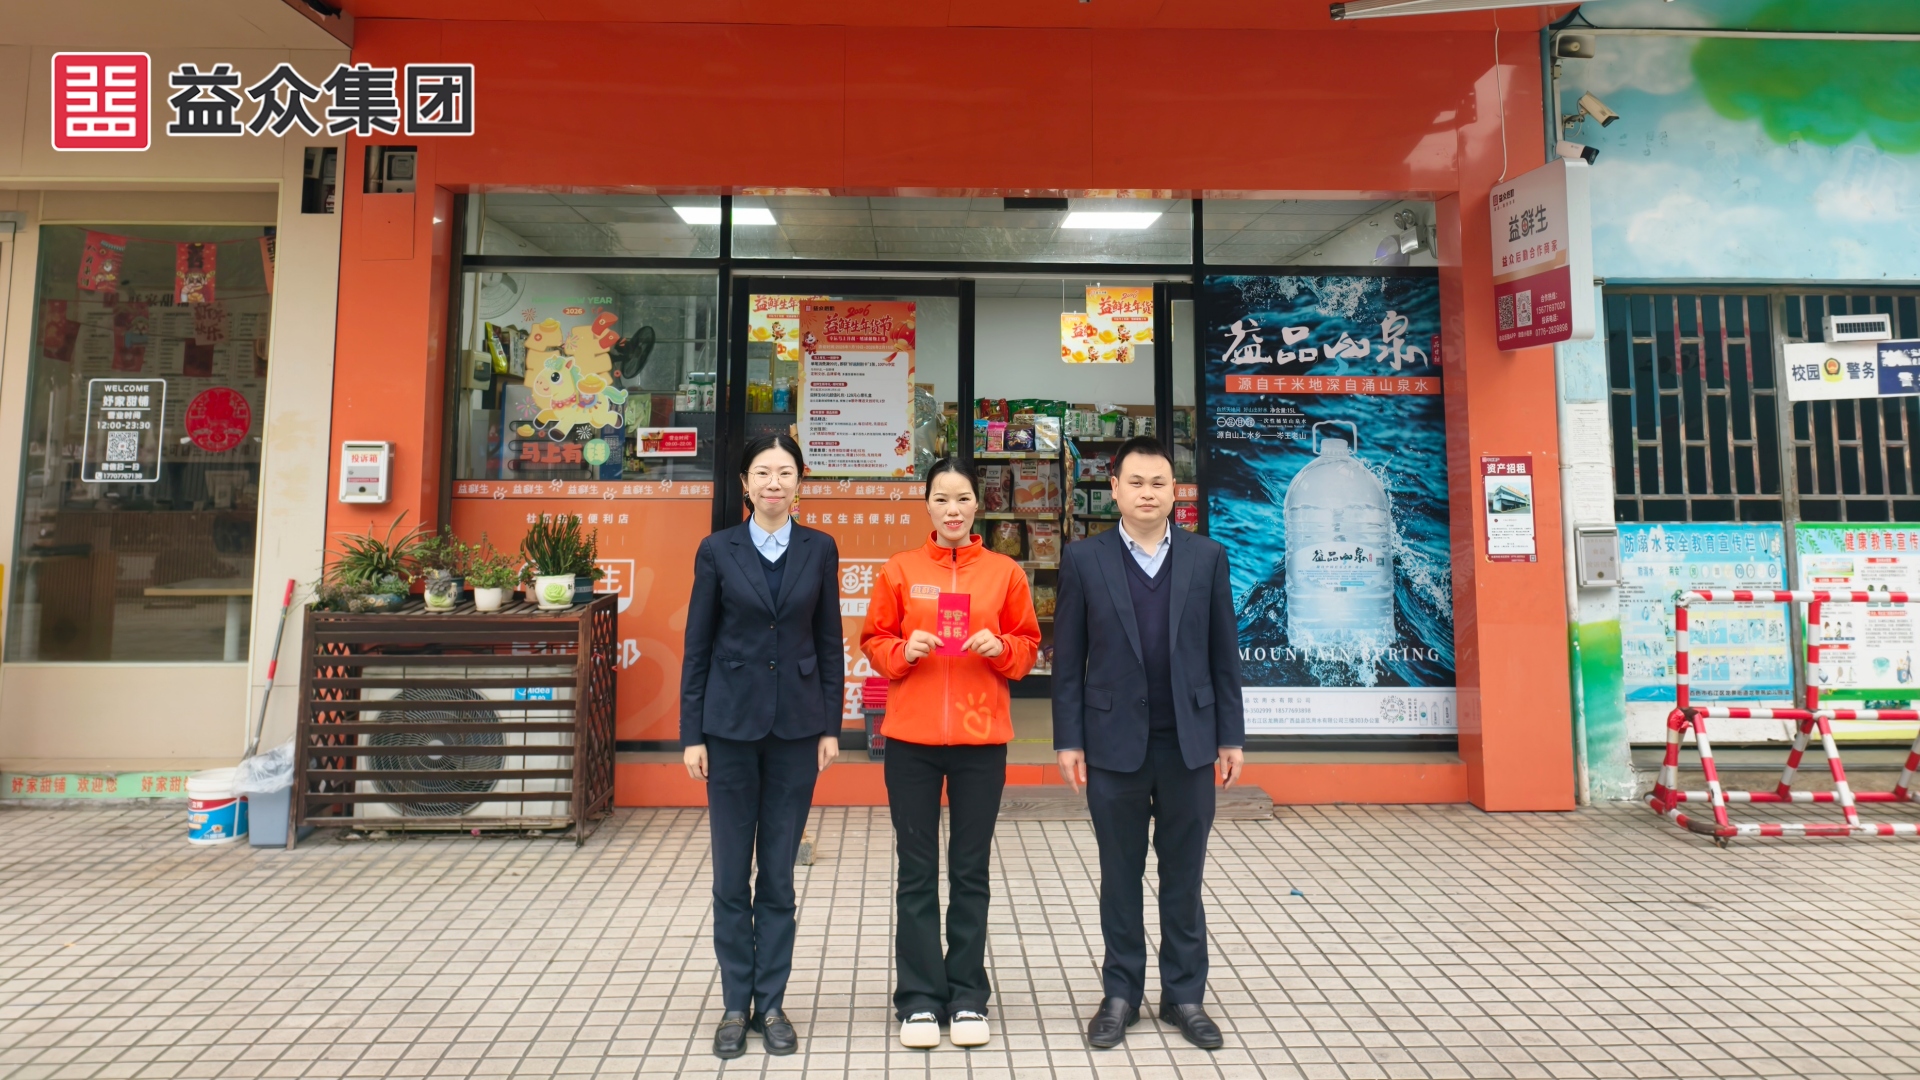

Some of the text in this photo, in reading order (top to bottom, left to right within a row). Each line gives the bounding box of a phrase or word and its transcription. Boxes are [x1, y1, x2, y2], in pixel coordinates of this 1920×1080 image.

[1508, 204, 1548, 242] 益鲜生
[1502, 239, 1558, 267] 益众后勤合作商家
[753, 295, 800, 313] 益鲜生年
[1098, 296, 1153, 315] 益鲜生年货
[823, 313, 893, 336] 益鲜生年货节
[1222, 310, 1429, 370] 益品山泉
[1792, 361, 1875, 381] 校园 警务
[104, 384, 149, 392] WELCOME
[1238, 377, 1429, 392] 源自千米地深自涌山泉水
[107, 411, 141, 419] 营业时间
[97, 421, 150, 430] 12:00-23:30
[1486, 463, 1526, 474] 资产招租
[457, 484, 711, 495] 益鲜生 益鲜生 益鲜生 益鲜生 益鲜生
[802, 485, 832, 495] 益鲜生
[855, 485, 885, 495] 益鲜生
[806, 513, 911, 525] 社区生活便利店
[1176, 508, 1187, 520] 移
[1623, 531, 1756, 553] 防溺水安全教育宣传栏
[1843, 532, 1919, 552] 健康教育宣传
[1312, 547, 1369, 562] 益品山泉
[596, 564, 622, 594] 生
[1637, 566, 1655, 577] 防溺水
[841, 564, 880, 595] 鲜
[943, 609, 963, 620] 平安
[943, 625, 963, 638] 喜乐
[1238, 647, 1440, 661] MOUNTAIN SPRING
[77, 777, 118, 793] 欢迎您
[141, 775, 188, 793] 妤家甜
